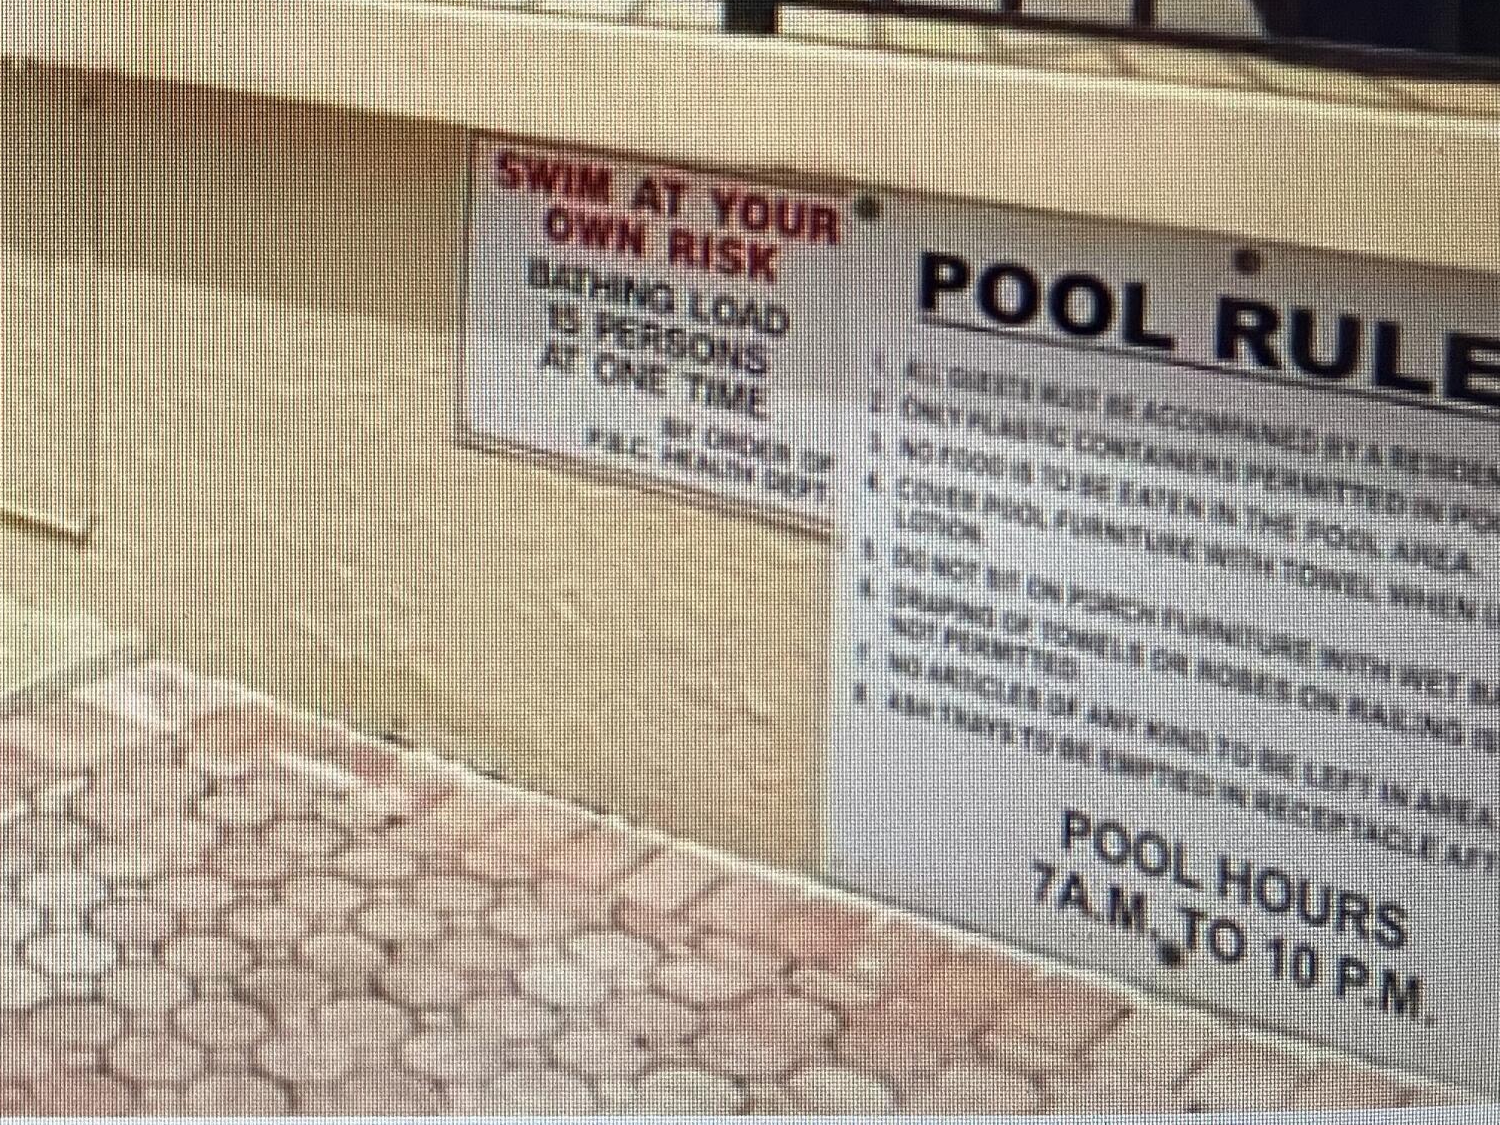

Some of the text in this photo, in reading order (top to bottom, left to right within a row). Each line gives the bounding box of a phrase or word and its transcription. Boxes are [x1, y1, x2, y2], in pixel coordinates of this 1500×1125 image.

[495, 151, 841, 246] SWIM AT YOUR
[543, 207, 780, 283] OWN RISK
[527, 257, 790, 338] BATHING LOAD
[548, 302, 769, 377] 15 PERSONS
[918, 250, 1500, 408] POOL RULE
[538, 342, 769, 421] AT ONE TIME
[662, 417, 694, 439] BY
[704, 425, 791, 463] ORDER
[1041, 382, 1099, 412] MUST
[1106, 393, 1134, 419] BE
[1324, 433, 1358, 462] BY
[1364, 442, 1383, 466] A
[661, 445, 754, 483] HEALTH
[899, 437, 933, 465] NO
[939, 445, 1004, 479] FOOD
[1012, 461, 1033, 487] IS
[1042, 463, 1074, 494] TO
[1079, 472, 1109, 502] BE
[1119, 479, 1203, 518] EATEN
[1212, 500, 1237, 526] IN
[1245, 504, 1295, 541] THE
[1305, 516, 1382, 561] POOL
[901, 394, 962, 424] ONLY
[967, 411, 1067, 451] PLASTIC
[1074, 429, 1237, 484] CONTAINERS
[1245, 463, 1406, 517] PERMITTED
[1411, 495, 1442, 524] IN
[896, 475, 977, 511] COVER
[983, 493, 1048, 532] POOL
[1053, 507, 1197, 562] FURNITURE
[1204, 541, 1274, 579] WITH
[1281, 557, 1380, 608] TOWEL
[1388, 581, 1477, 624] WHEN
[890, 615, 936, 641] NOT
[892, 583, 994, 628] DRAPING
[1002, 610, 1030, 635] OF
[1042, 619, 1142, 668] TOWELS
[1151, 647, 1188, 675] OR
[1198, 658, 1291, 704] ROBES
[1300, 684, 1339, 715] ON
[1349, 694, 1464, 747] RAILING
[893, 544, 927, 574] DO
[932, 555, 978, 583] NOT
[1027, 575, 1062, 603] ON
[1069, 584, 1155, 623] PORCH
[1162, 604, 1312, 668] FURNITURE
[1322, 647, 1392, 683] WITH
[1401, 665, 1459, 699] WET
[887, 651, 921, 679] NO
[929, 664, 1040, 711] ARTICLES
[1047, 692, 1077, 718] OF
[1087, 702, 1137, 736] ANY
[1145, 720, 1209, 757] KIND
[1217, 734, 1252, 768] TO
[1259, 745, 1295, 780] BE
[1304, 760, 1372, 801] LEFT
[1380, 780, 1409, 807] IN
[940, 701, 1013, 745] TRAYS
[1022, 725, 1053, 755] TO
[1060, 735, 1091, 763] BE
[1101, 745, 1213, 799] EMPTIED
[1220, 782, 1247, 808] IN
[1255, 787, 1436, 861] RECEPTACLE
[1060, 808, 1409, 951] POOL HOURS
[1180, 904, 1246, 965] TO
[1267, 936, 1320, 990] 10
[1335, 955, 1438, 1029] P.M.
